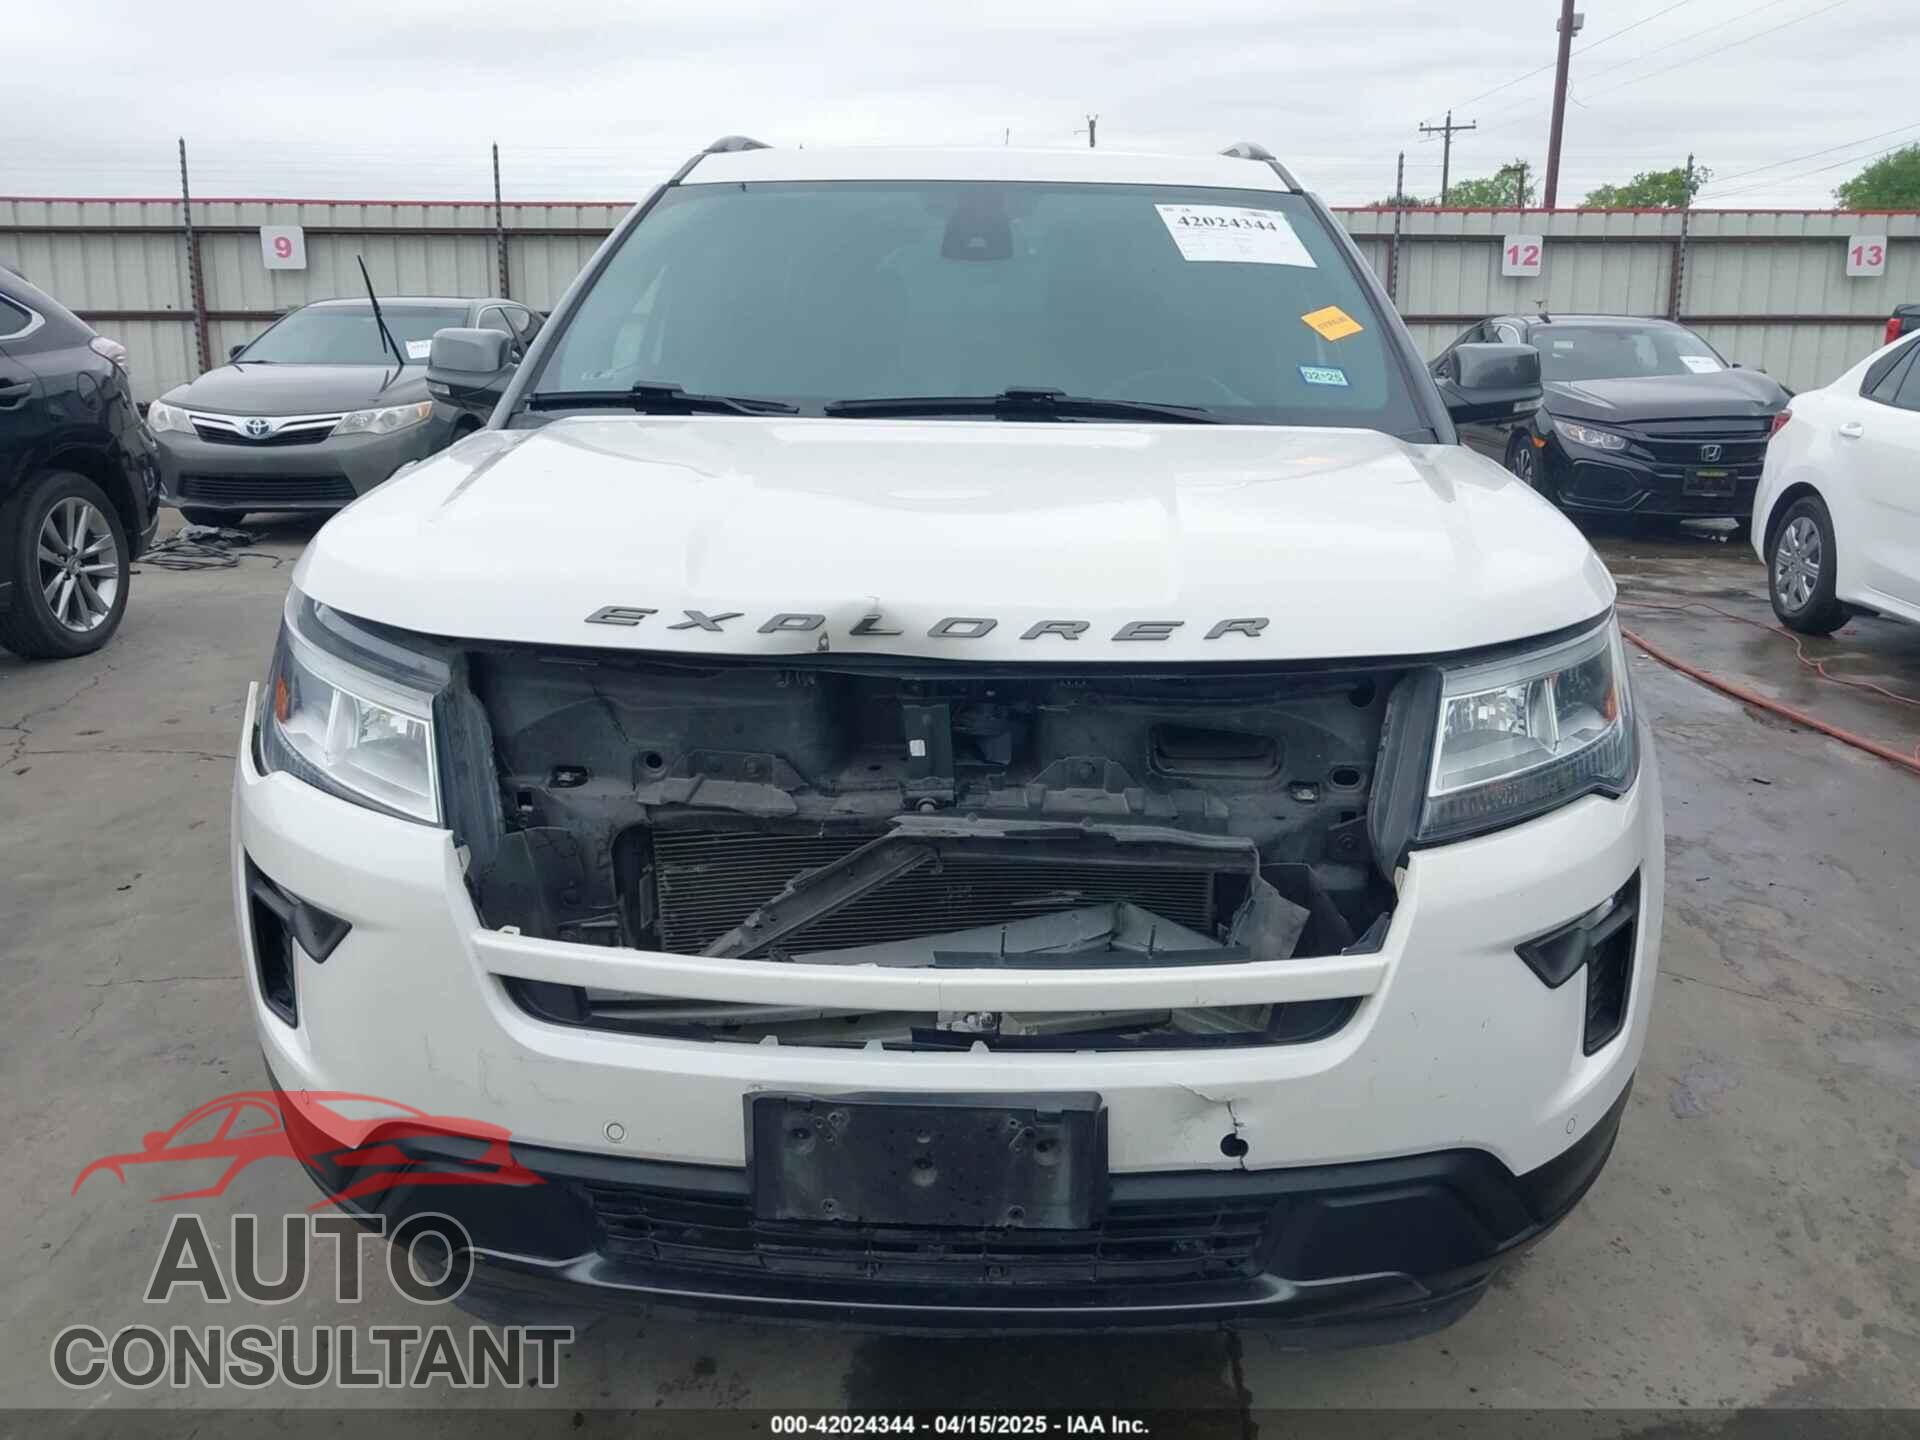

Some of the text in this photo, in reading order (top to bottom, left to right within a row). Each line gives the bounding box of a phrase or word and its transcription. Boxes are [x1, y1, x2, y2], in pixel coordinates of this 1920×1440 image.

[1177, 215, 1278, 232] 42024344
[275, 236, 292, 258] 9
[1507, 244, 1539, 266] 12
[1851, 245, 1882, 266] 13
[584, 604, 1270, 642] EXPLORER
